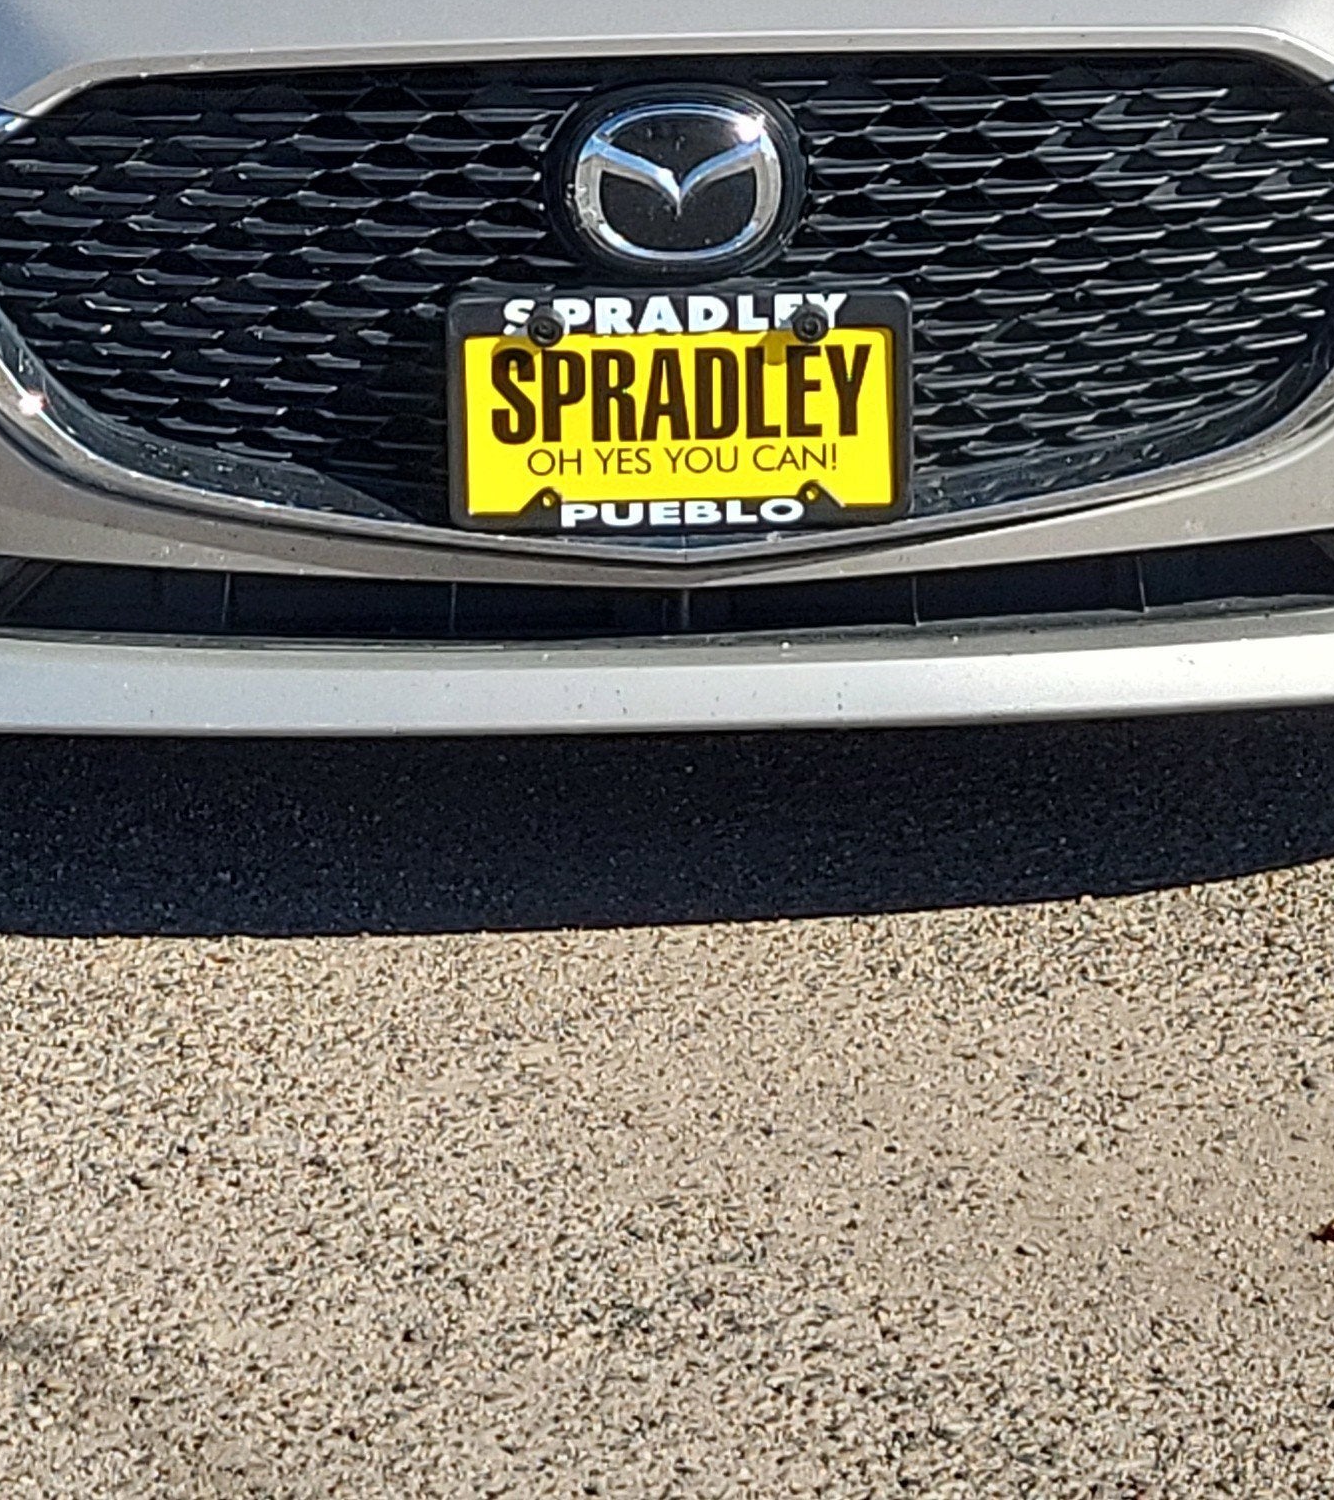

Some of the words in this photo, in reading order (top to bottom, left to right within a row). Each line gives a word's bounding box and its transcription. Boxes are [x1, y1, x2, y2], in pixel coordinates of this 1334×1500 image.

[491, 343, 873, 446] SPRADLEY
[527, 448, 583, 476] OH
[594, 447, 652, 475] YES
[665, 445, 739, 474] YOU
[752, 443, 838, 473] CAN!
[560, 499, 805, 528] PUEBLO
